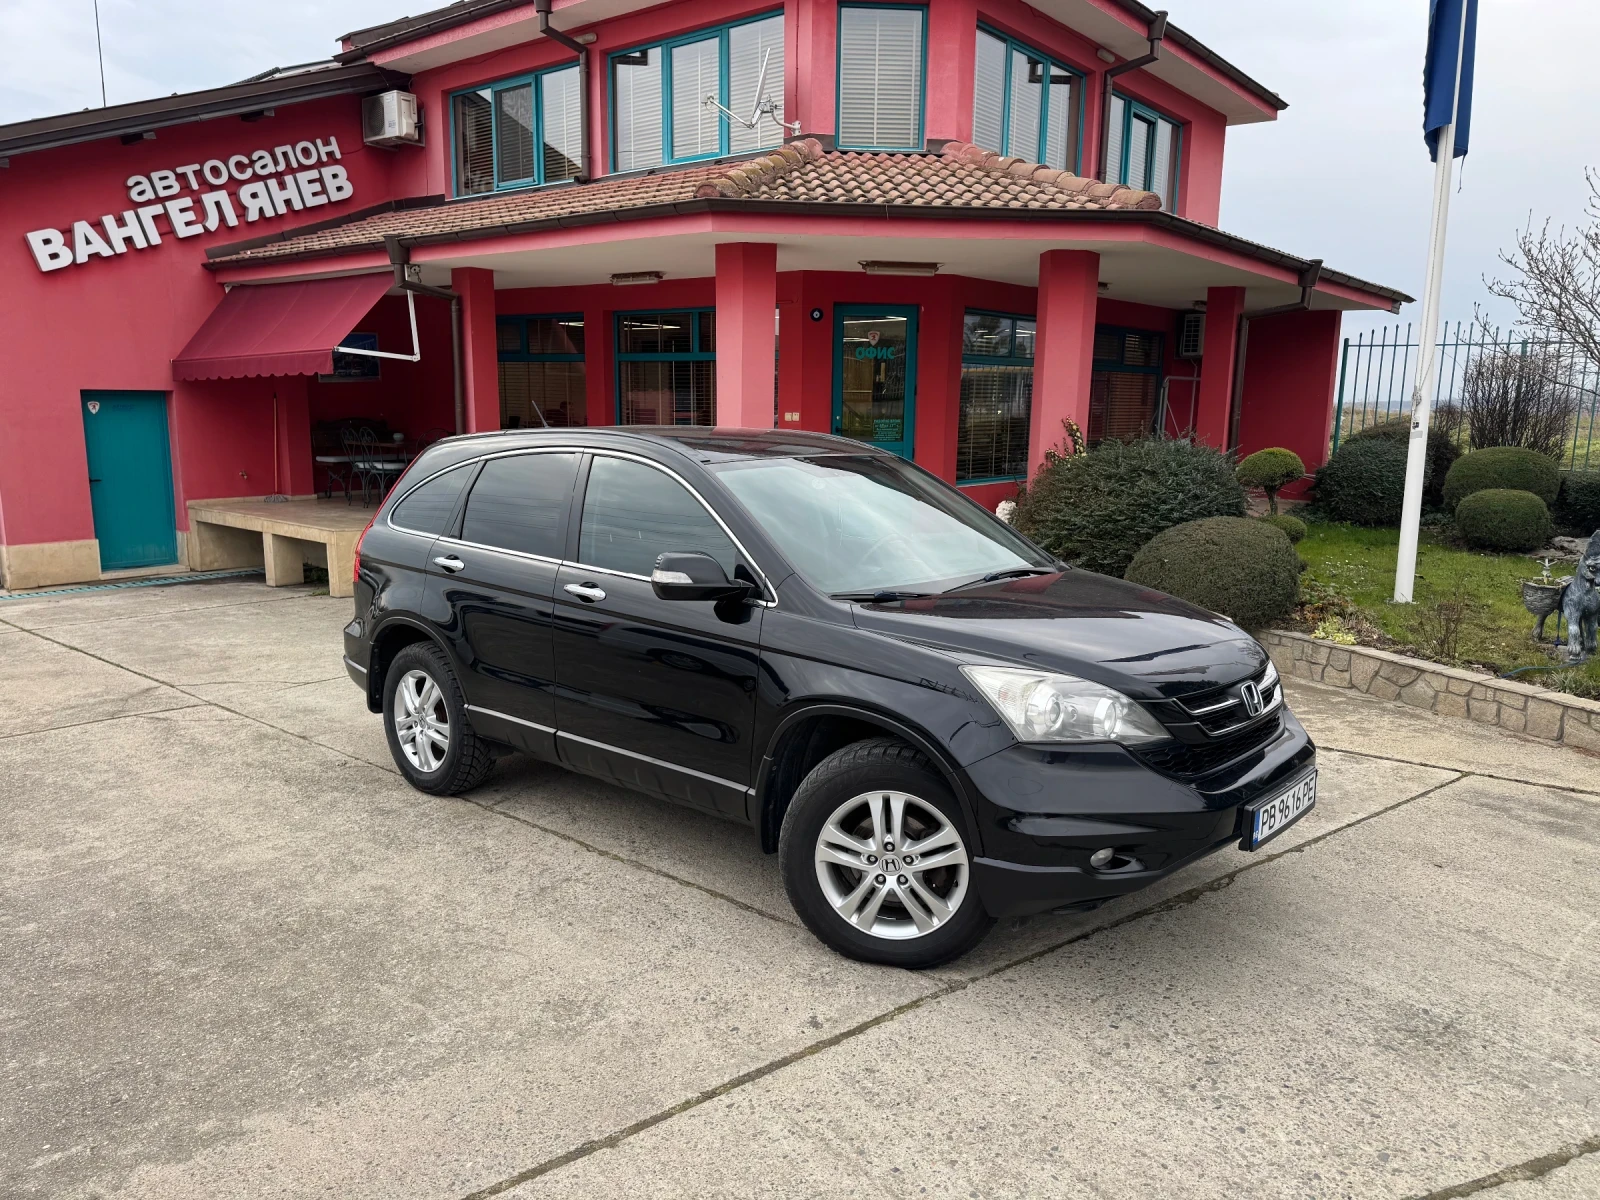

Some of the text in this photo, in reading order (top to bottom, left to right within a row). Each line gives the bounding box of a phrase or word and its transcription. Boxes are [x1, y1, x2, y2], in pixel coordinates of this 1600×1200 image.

[126, 136, 342, 203] автосалон
[24, 164, 354, 273] ВАНГЕЛ ЯНЕВ
[855, 346, 896, 360] ОФИС
[1260, 803, 1276, 836] PB
